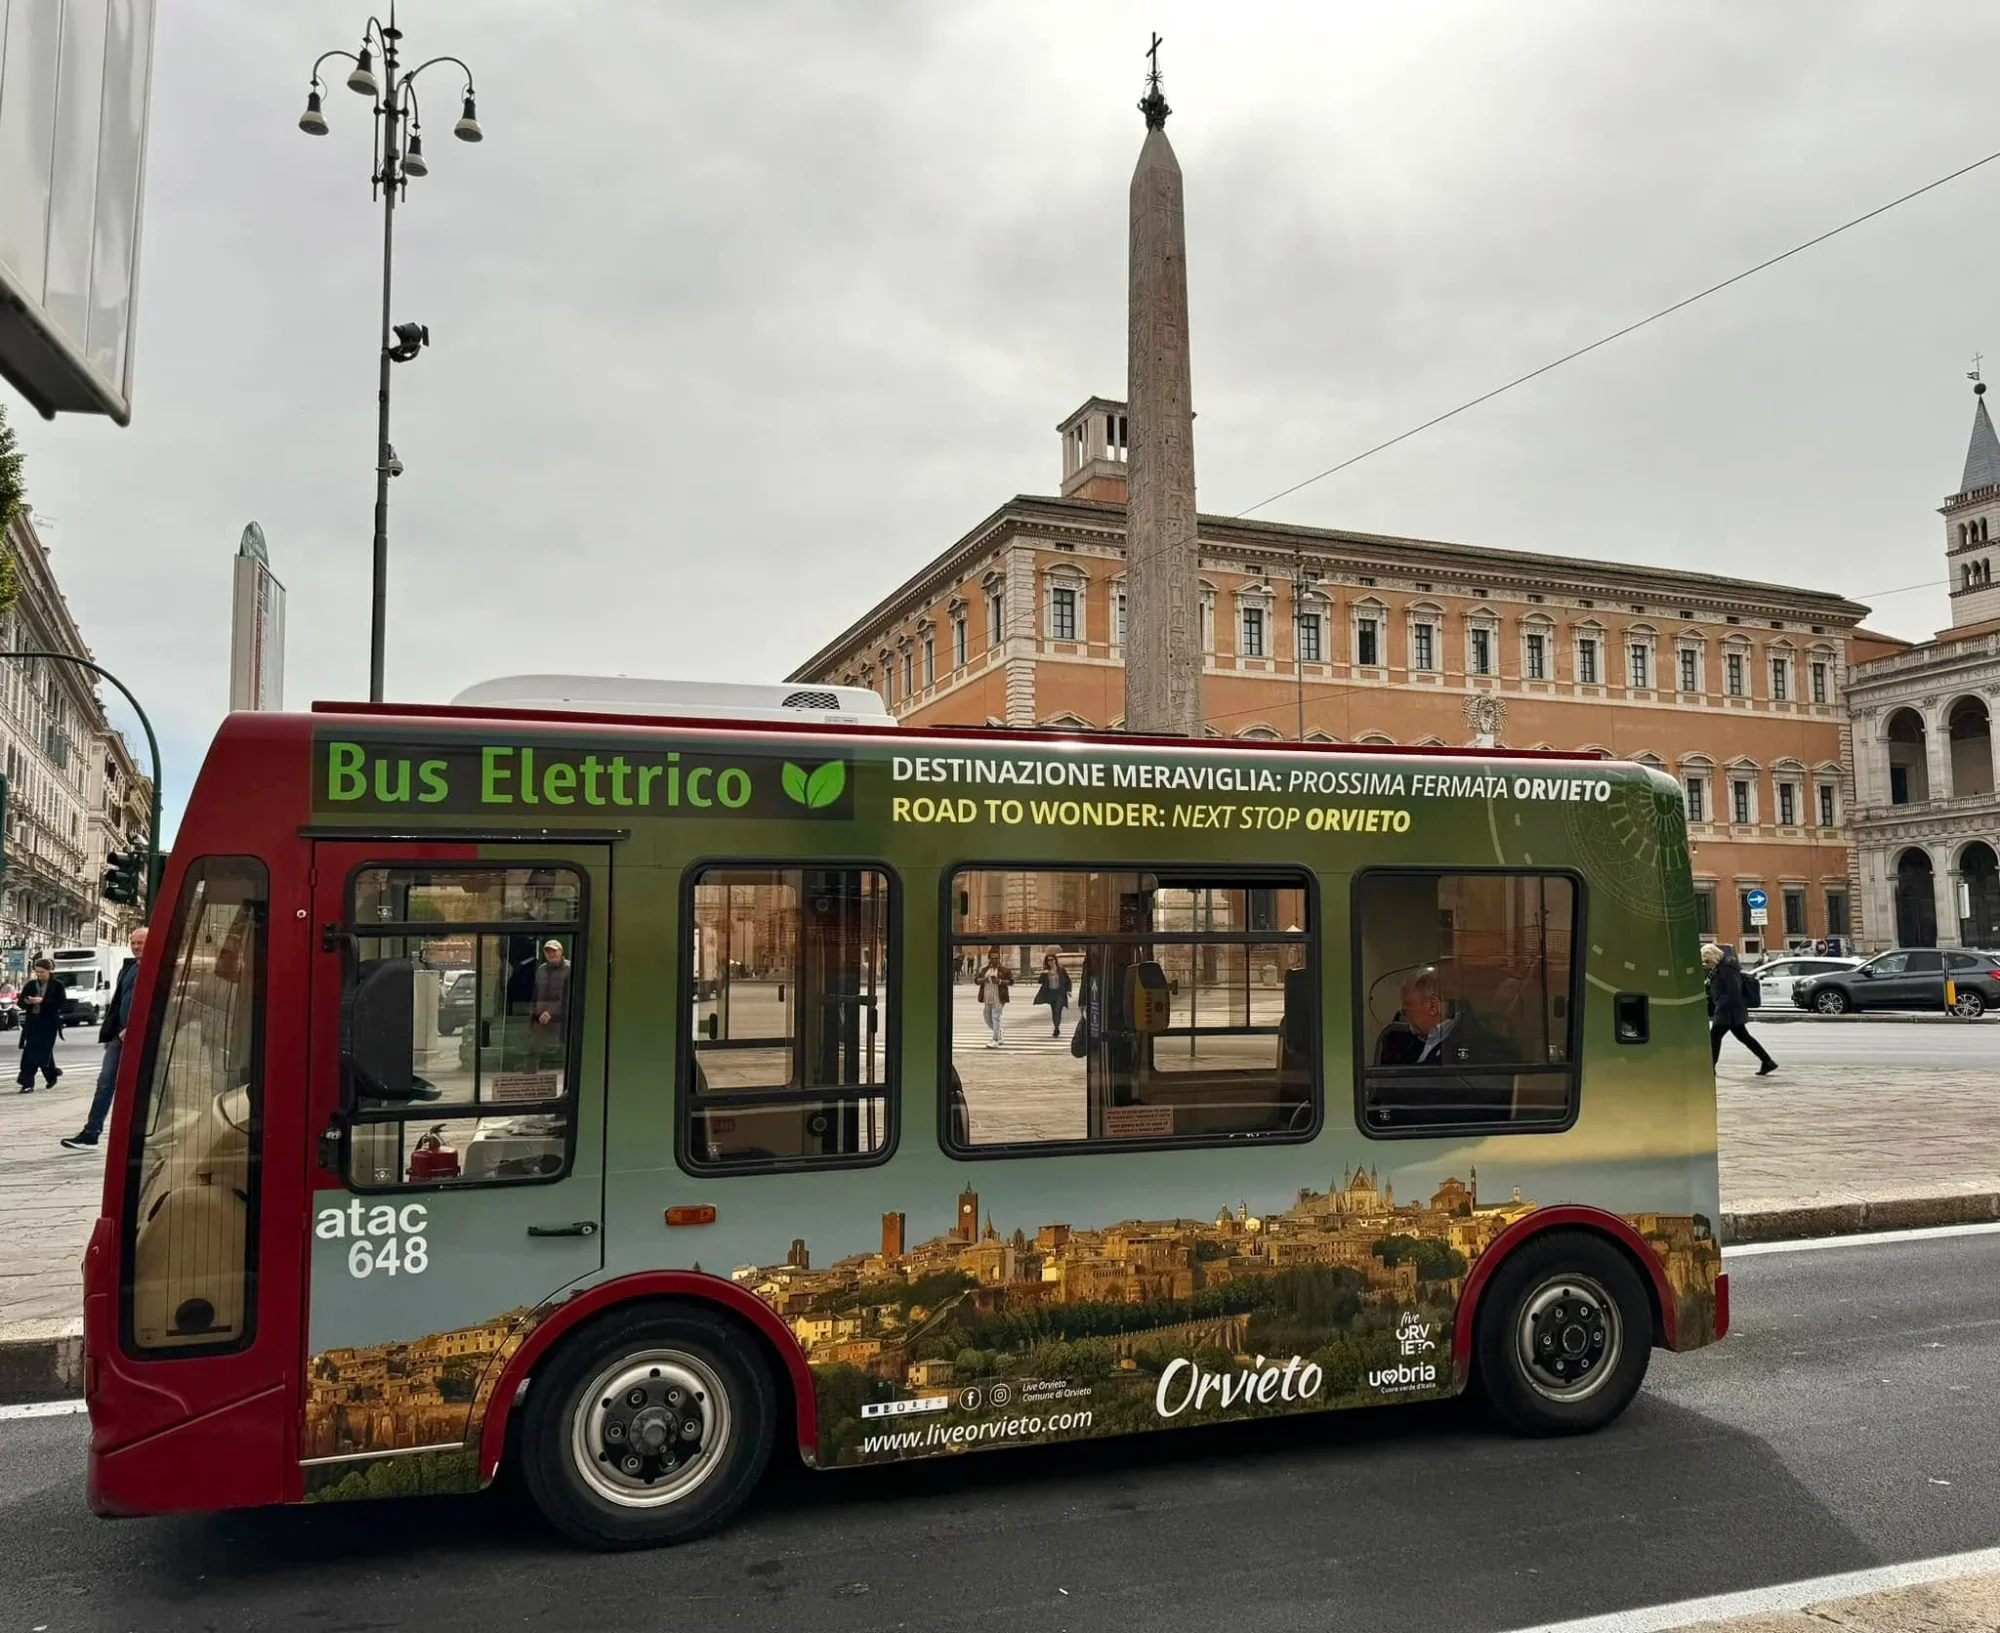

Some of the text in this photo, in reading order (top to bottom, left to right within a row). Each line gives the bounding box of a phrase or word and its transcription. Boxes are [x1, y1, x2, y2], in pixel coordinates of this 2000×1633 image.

[328, 742, 752, 807] Bus Elettrico
[892, 757, 1611, 802] DESTINAZIONE MERAVIGLIA: PROSSIMA FERMATA ORVIETO
[892, 797, 1411, 833] ROAD TO WONDER: NEXT STOP ORVIETO
[315, 1198, 428, 1239] atac
[348, 1236, 429, 1279] 648
[1022, 1380, 1067, 1392] Live Orvieto
[1022, 1387, 1092, 1402] Comune di Orvieto
[1156, 1354, 1323, 1418] Orvieto
[864, 1410, 1093, 1453] www.liveorvieto.com
